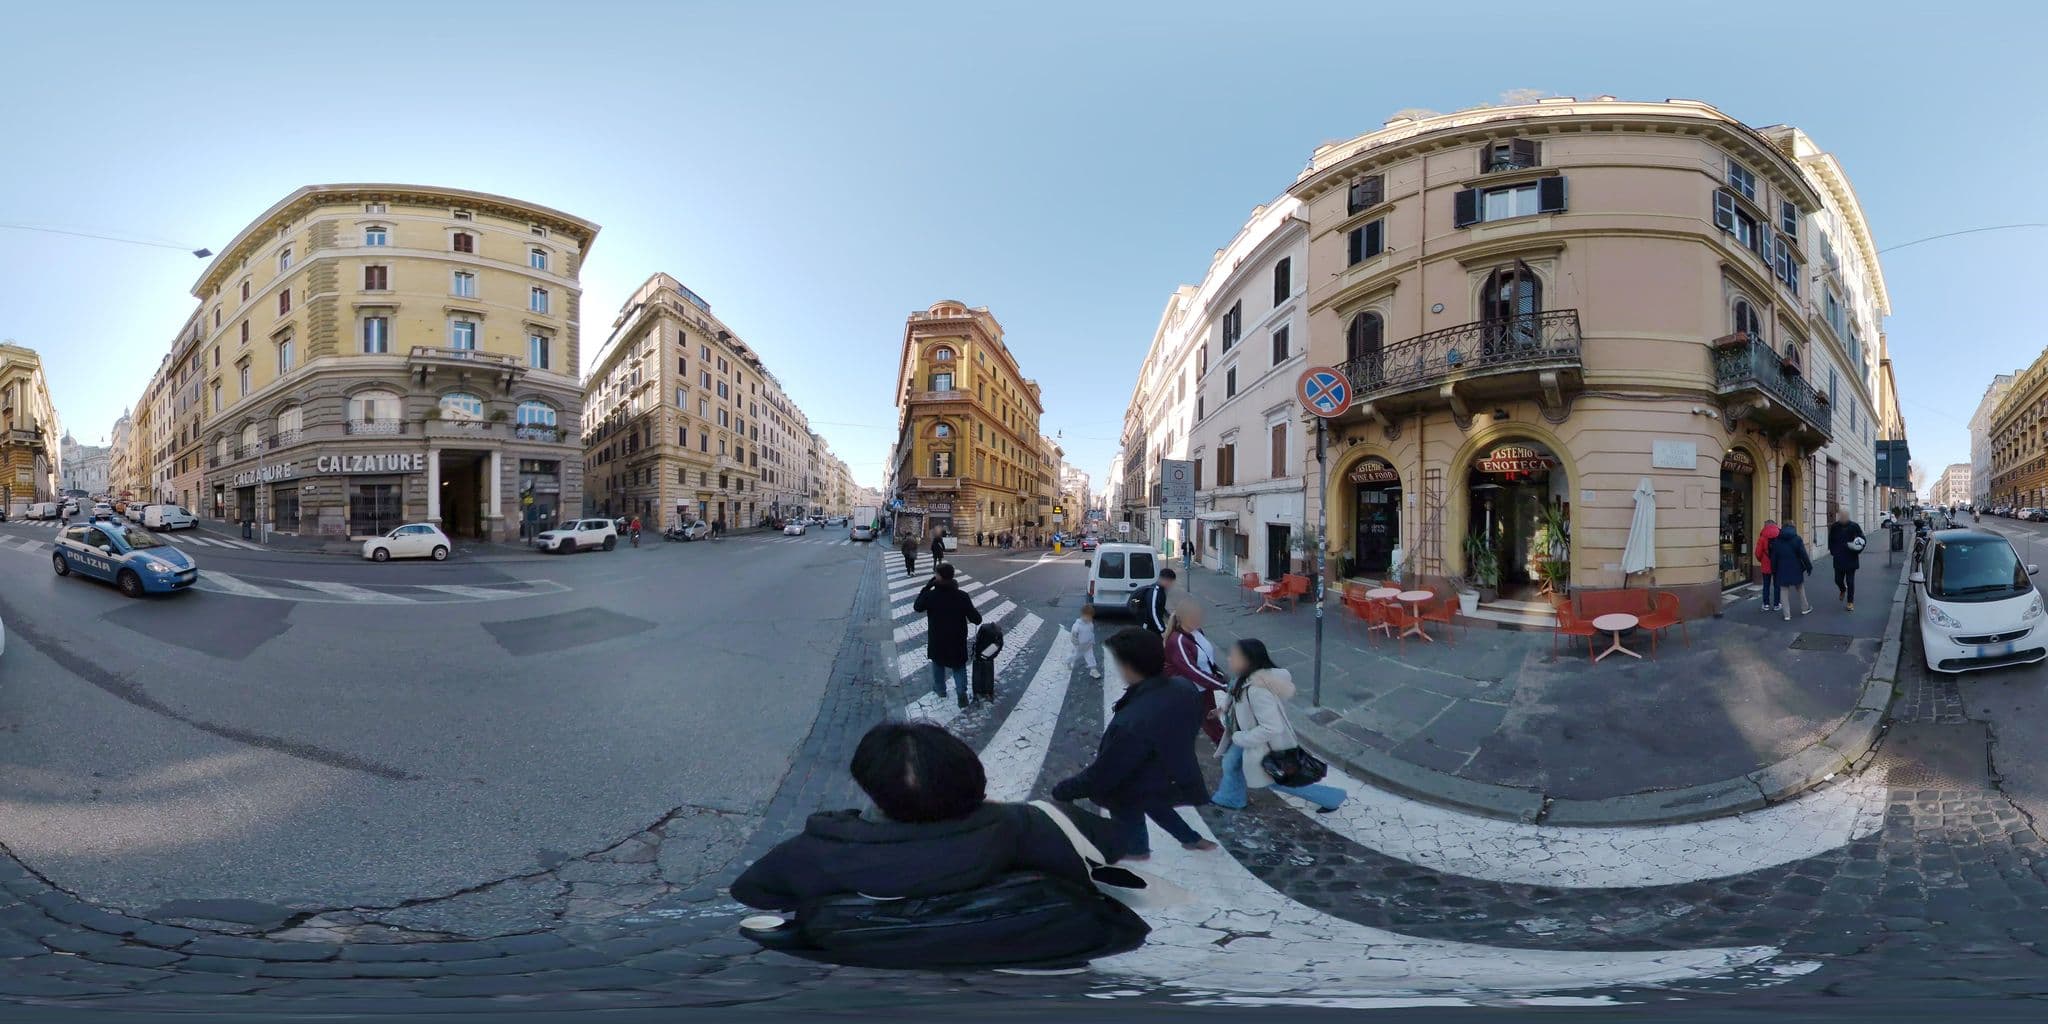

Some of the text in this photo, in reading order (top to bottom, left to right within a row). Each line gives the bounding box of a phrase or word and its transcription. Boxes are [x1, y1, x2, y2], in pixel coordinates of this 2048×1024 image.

[1496, 447, 1533, 459] ASTEMIO
[317, 454, 424, 472] CALZATURE
[1483, 459, 1548, 471] ENOTECA
[1375, 471, 1393, 480] FOOD
[67, 550, 111, 572] POLIZIA
